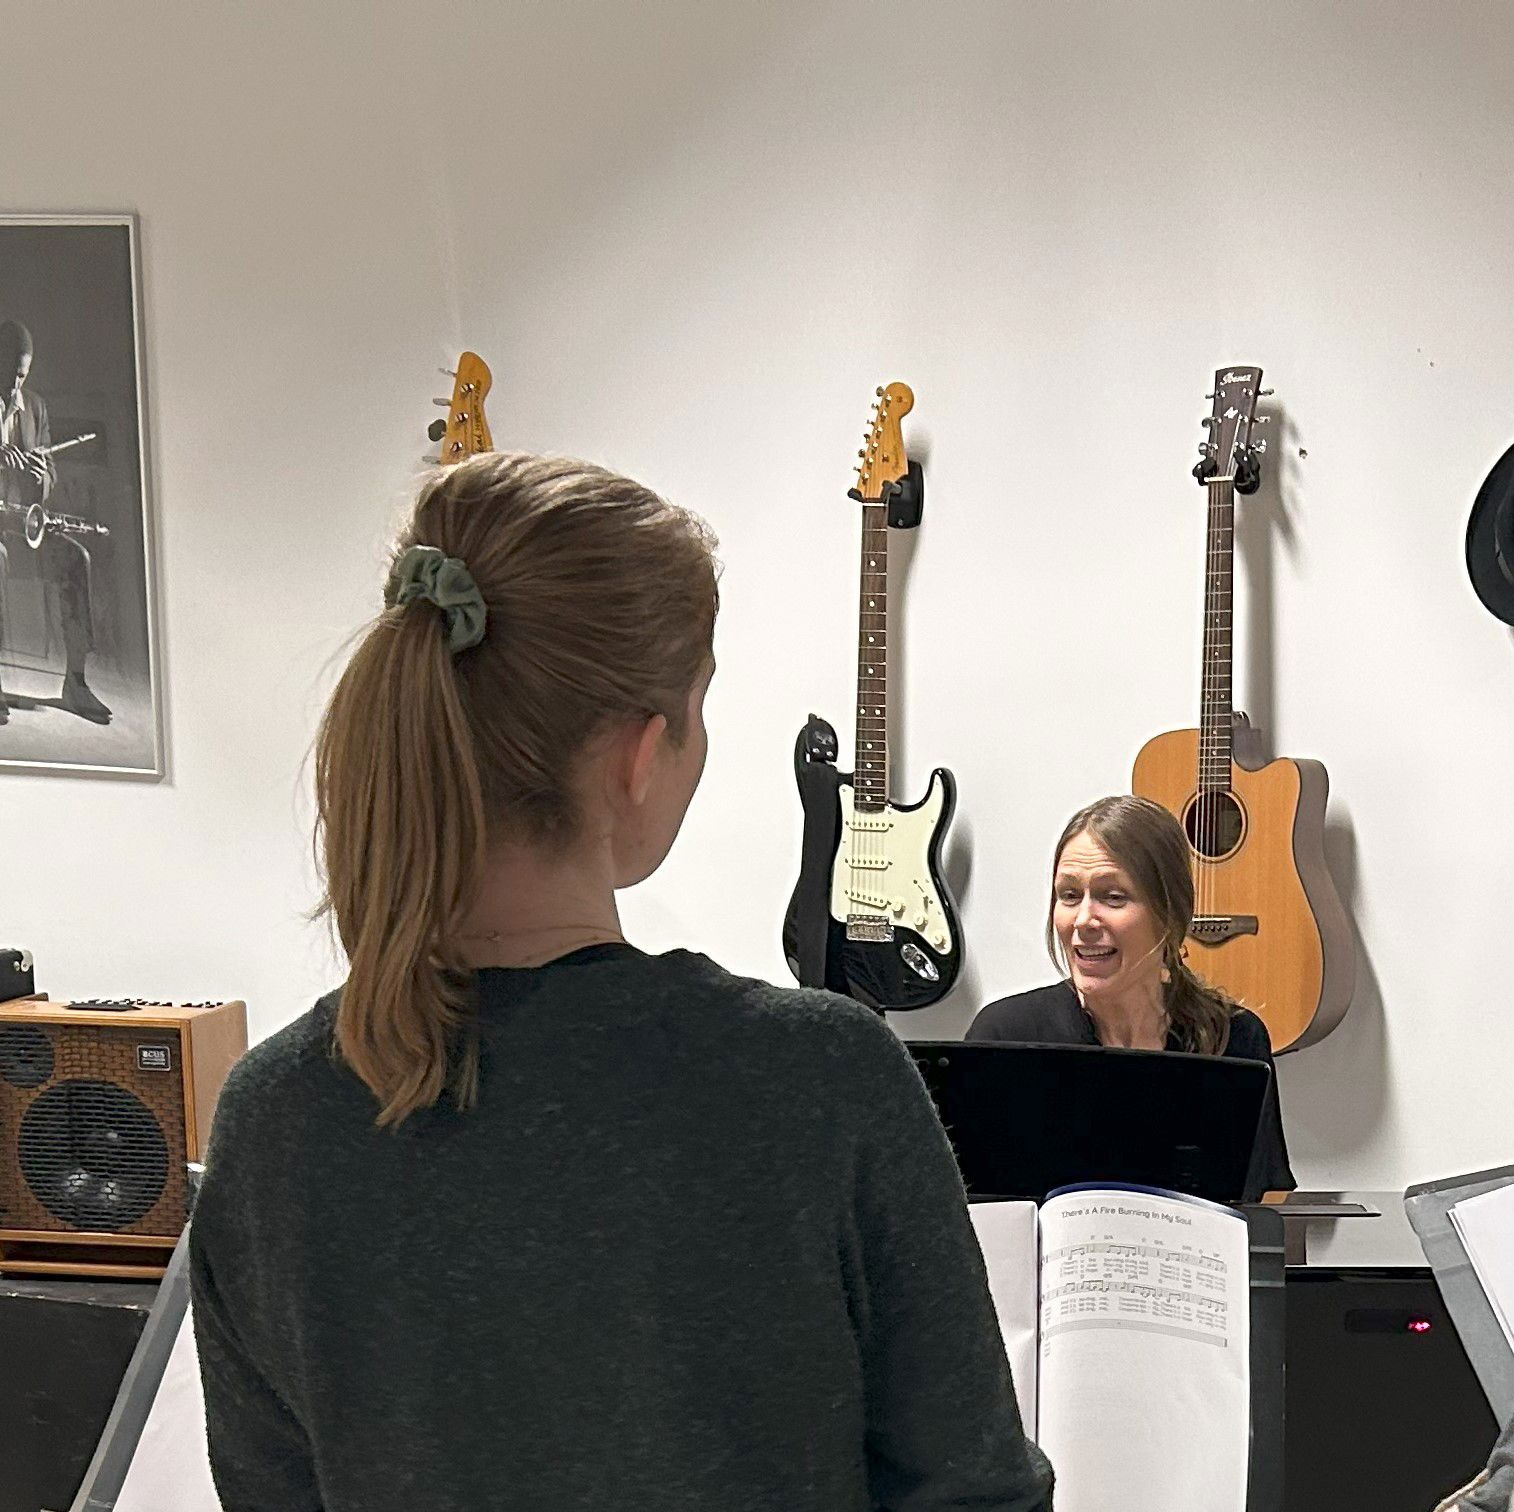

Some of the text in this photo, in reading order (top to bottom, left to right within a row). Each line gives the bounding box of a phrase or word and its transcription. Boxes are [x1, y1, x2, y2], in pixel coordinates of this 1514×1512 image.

[1062, 1208, 1089, 1218] There's
[1100, 1206, 1116, 1214] Fire
[1118, 1207, 1150, 1218] Burning
[1152, 1211, 1159, 1219] In
[1161, 1212, 1173, 1223] My
[1175, 1215, 1192, 1225] Soul
